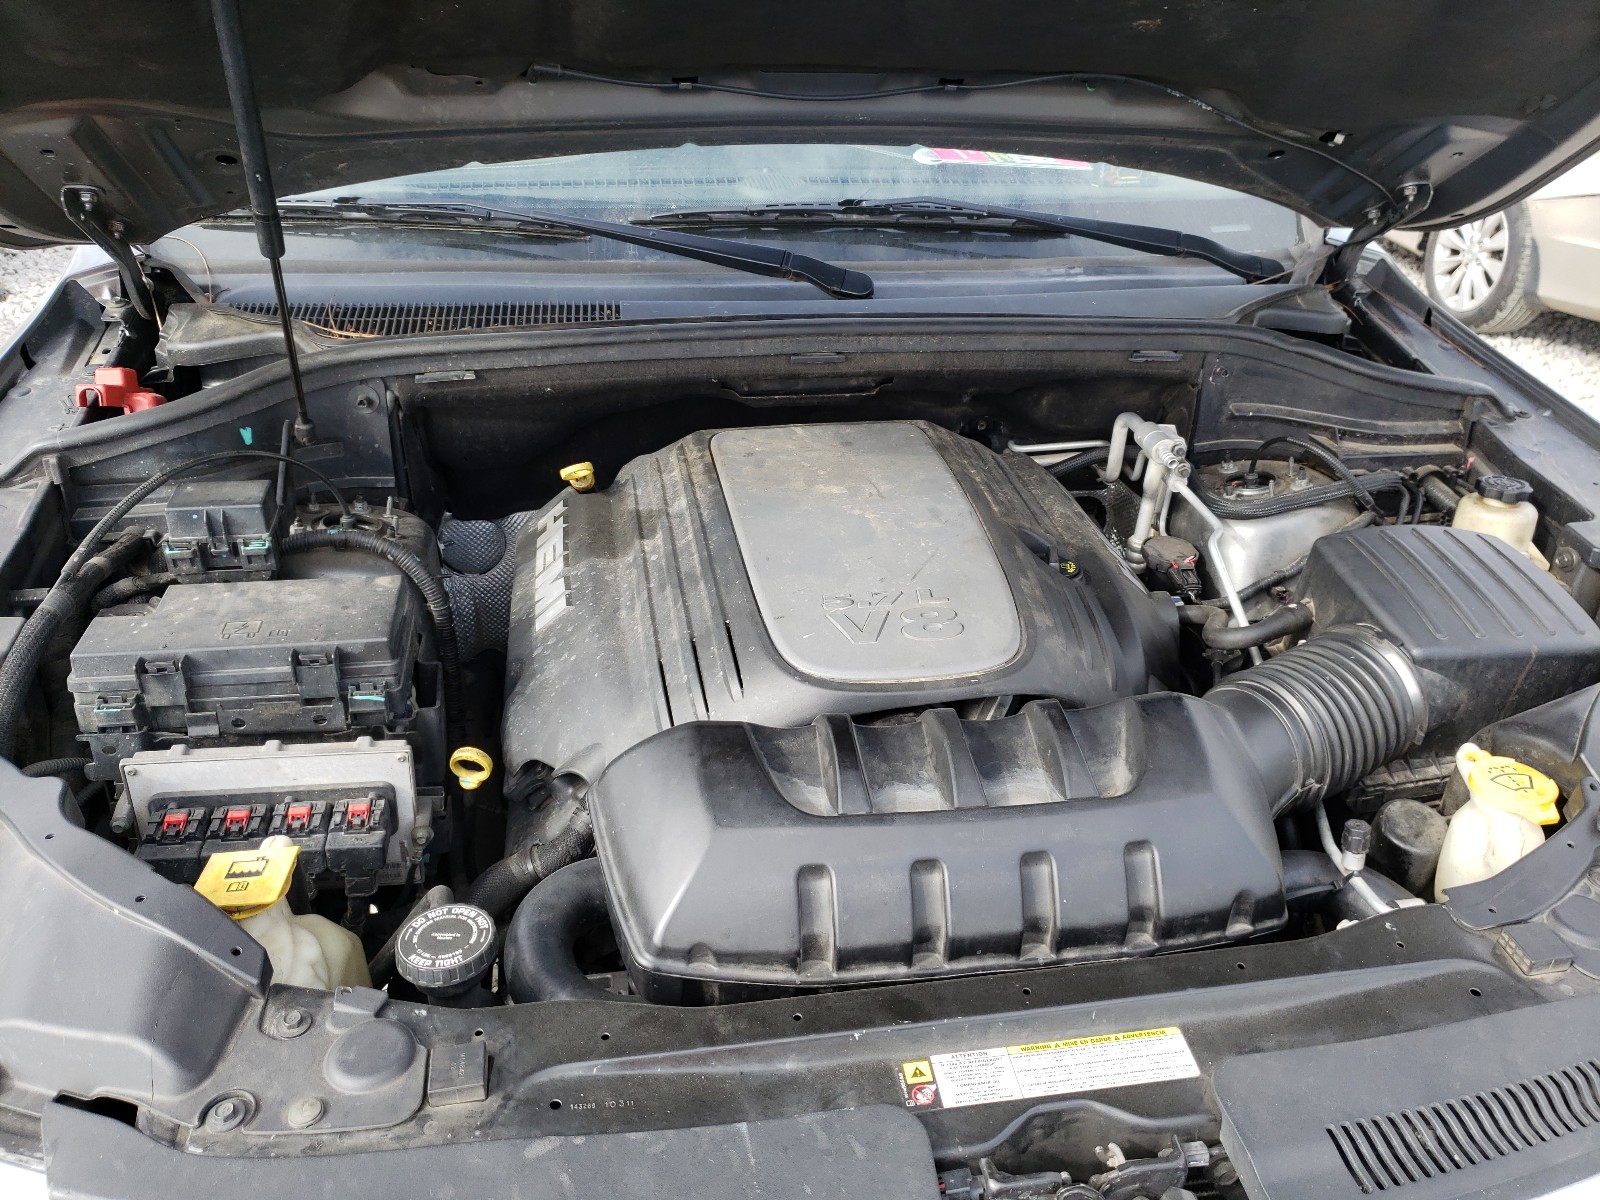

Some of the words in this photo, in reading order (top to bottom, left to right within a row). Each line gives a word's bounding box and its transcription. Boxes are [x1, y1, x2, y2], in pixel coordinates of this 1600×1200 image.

[535, 499, 568, 632] HEMI
[824, 605, 965, 645] V8
[411, 917, 426, 928] DO
[427, 908, 449, 919] NOT
[451, 907, 479, 918] OPEN
[474, 915, 489, 929] HOT
[407, 953, 433, 967] KEEP
[434, 955, 463, 967] TIGHT
[951, 1051, 988, 1059] ATTENTION
[1020, 1043, 1052, 1052] WARNING
